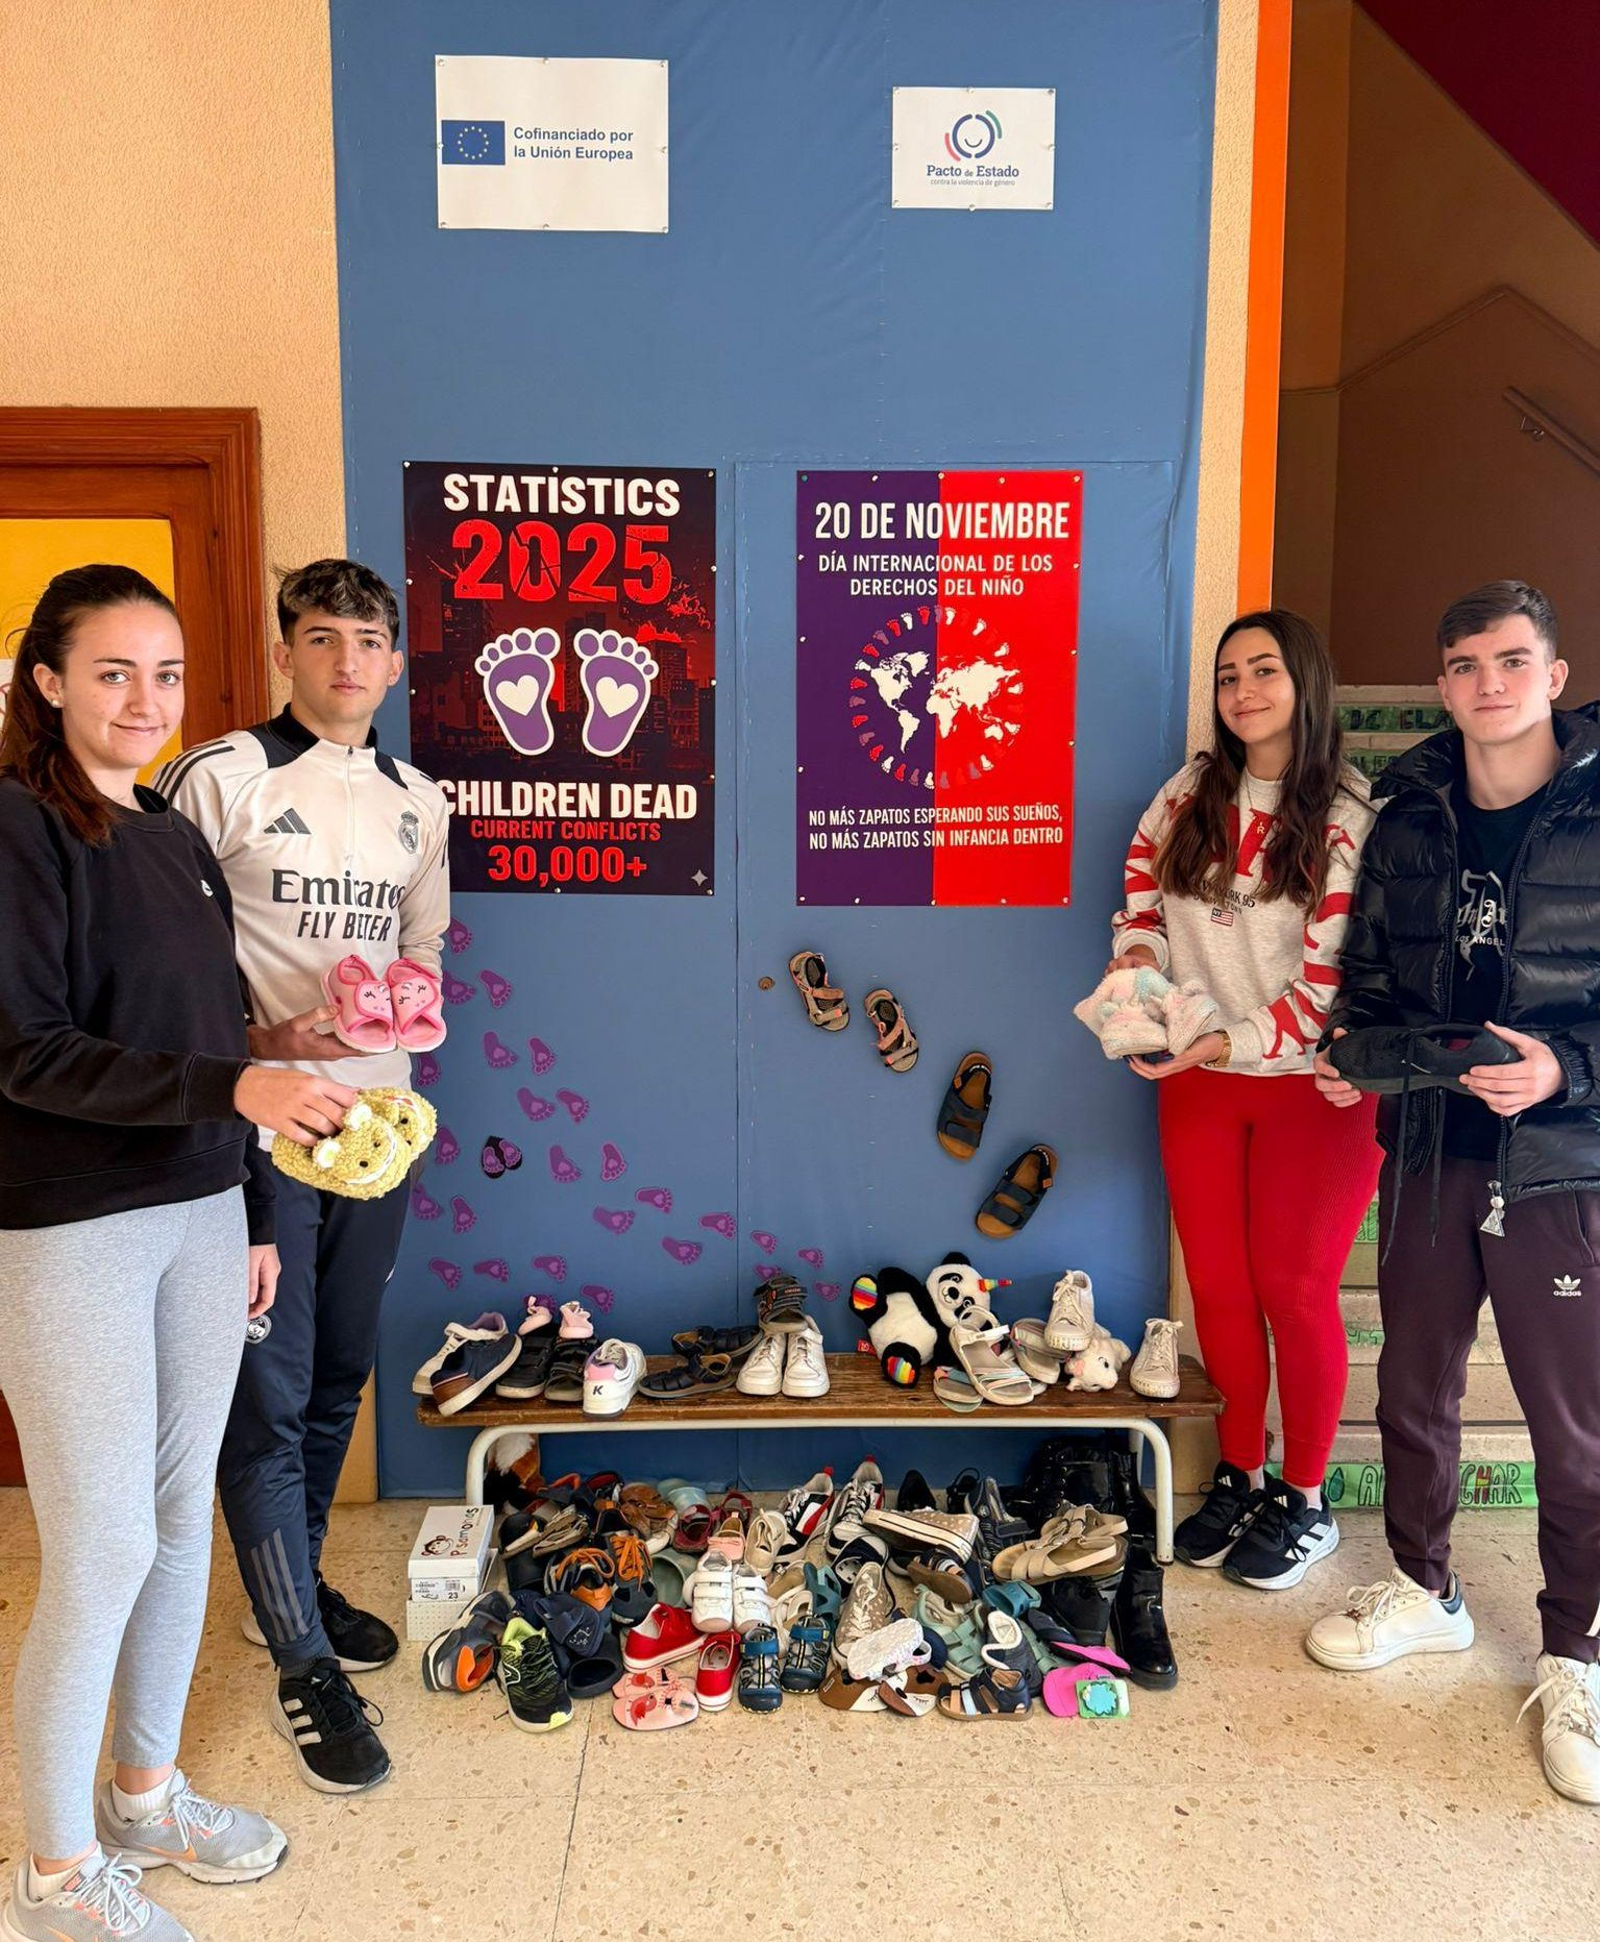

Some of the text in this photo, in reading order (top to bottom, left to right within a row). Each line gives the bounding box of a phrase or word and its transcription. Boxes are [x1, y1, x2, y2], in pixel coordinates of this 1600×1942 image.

[513, 126, 634, 144] Cofinanciado por
[513, 145, 634, 162] la Unión Europea
[926, 164, 1020, 178] Pacto de Estado
[930, 178, 950, 186] contra
[443, 473, 681, 518] STATISTICS
[815, 501, 1071, 540] 20 DE NOVIEMBRE
[452, 518, 673, 606] 2025
[818, 551, 1054, 574] DÍA INTERNACIONAL DE LOS
[850, 575, 1025, 597] DERECHOS DEL NIÑO
[436, 779, 697, 819] CHILDREN DEAD
[808, 802, 1063, 827] NO MÁS ZAPATOS ESPERANDO SUS SUEÑOS,
[470, 819, 662, 842] CURRENT CONFLICTS
[809, 826, 1064, 850] NO MÁS ZAPATOS SIN INFANCIA DENTRO
[487, 844, 648, 888] 30,000+
[296, 911, 337, 939] FLY
[1472, 936, 1506, 947] ANGEL
[592, 1384, 604, 1396] K
[447, 1591, 459, 1600] 23
